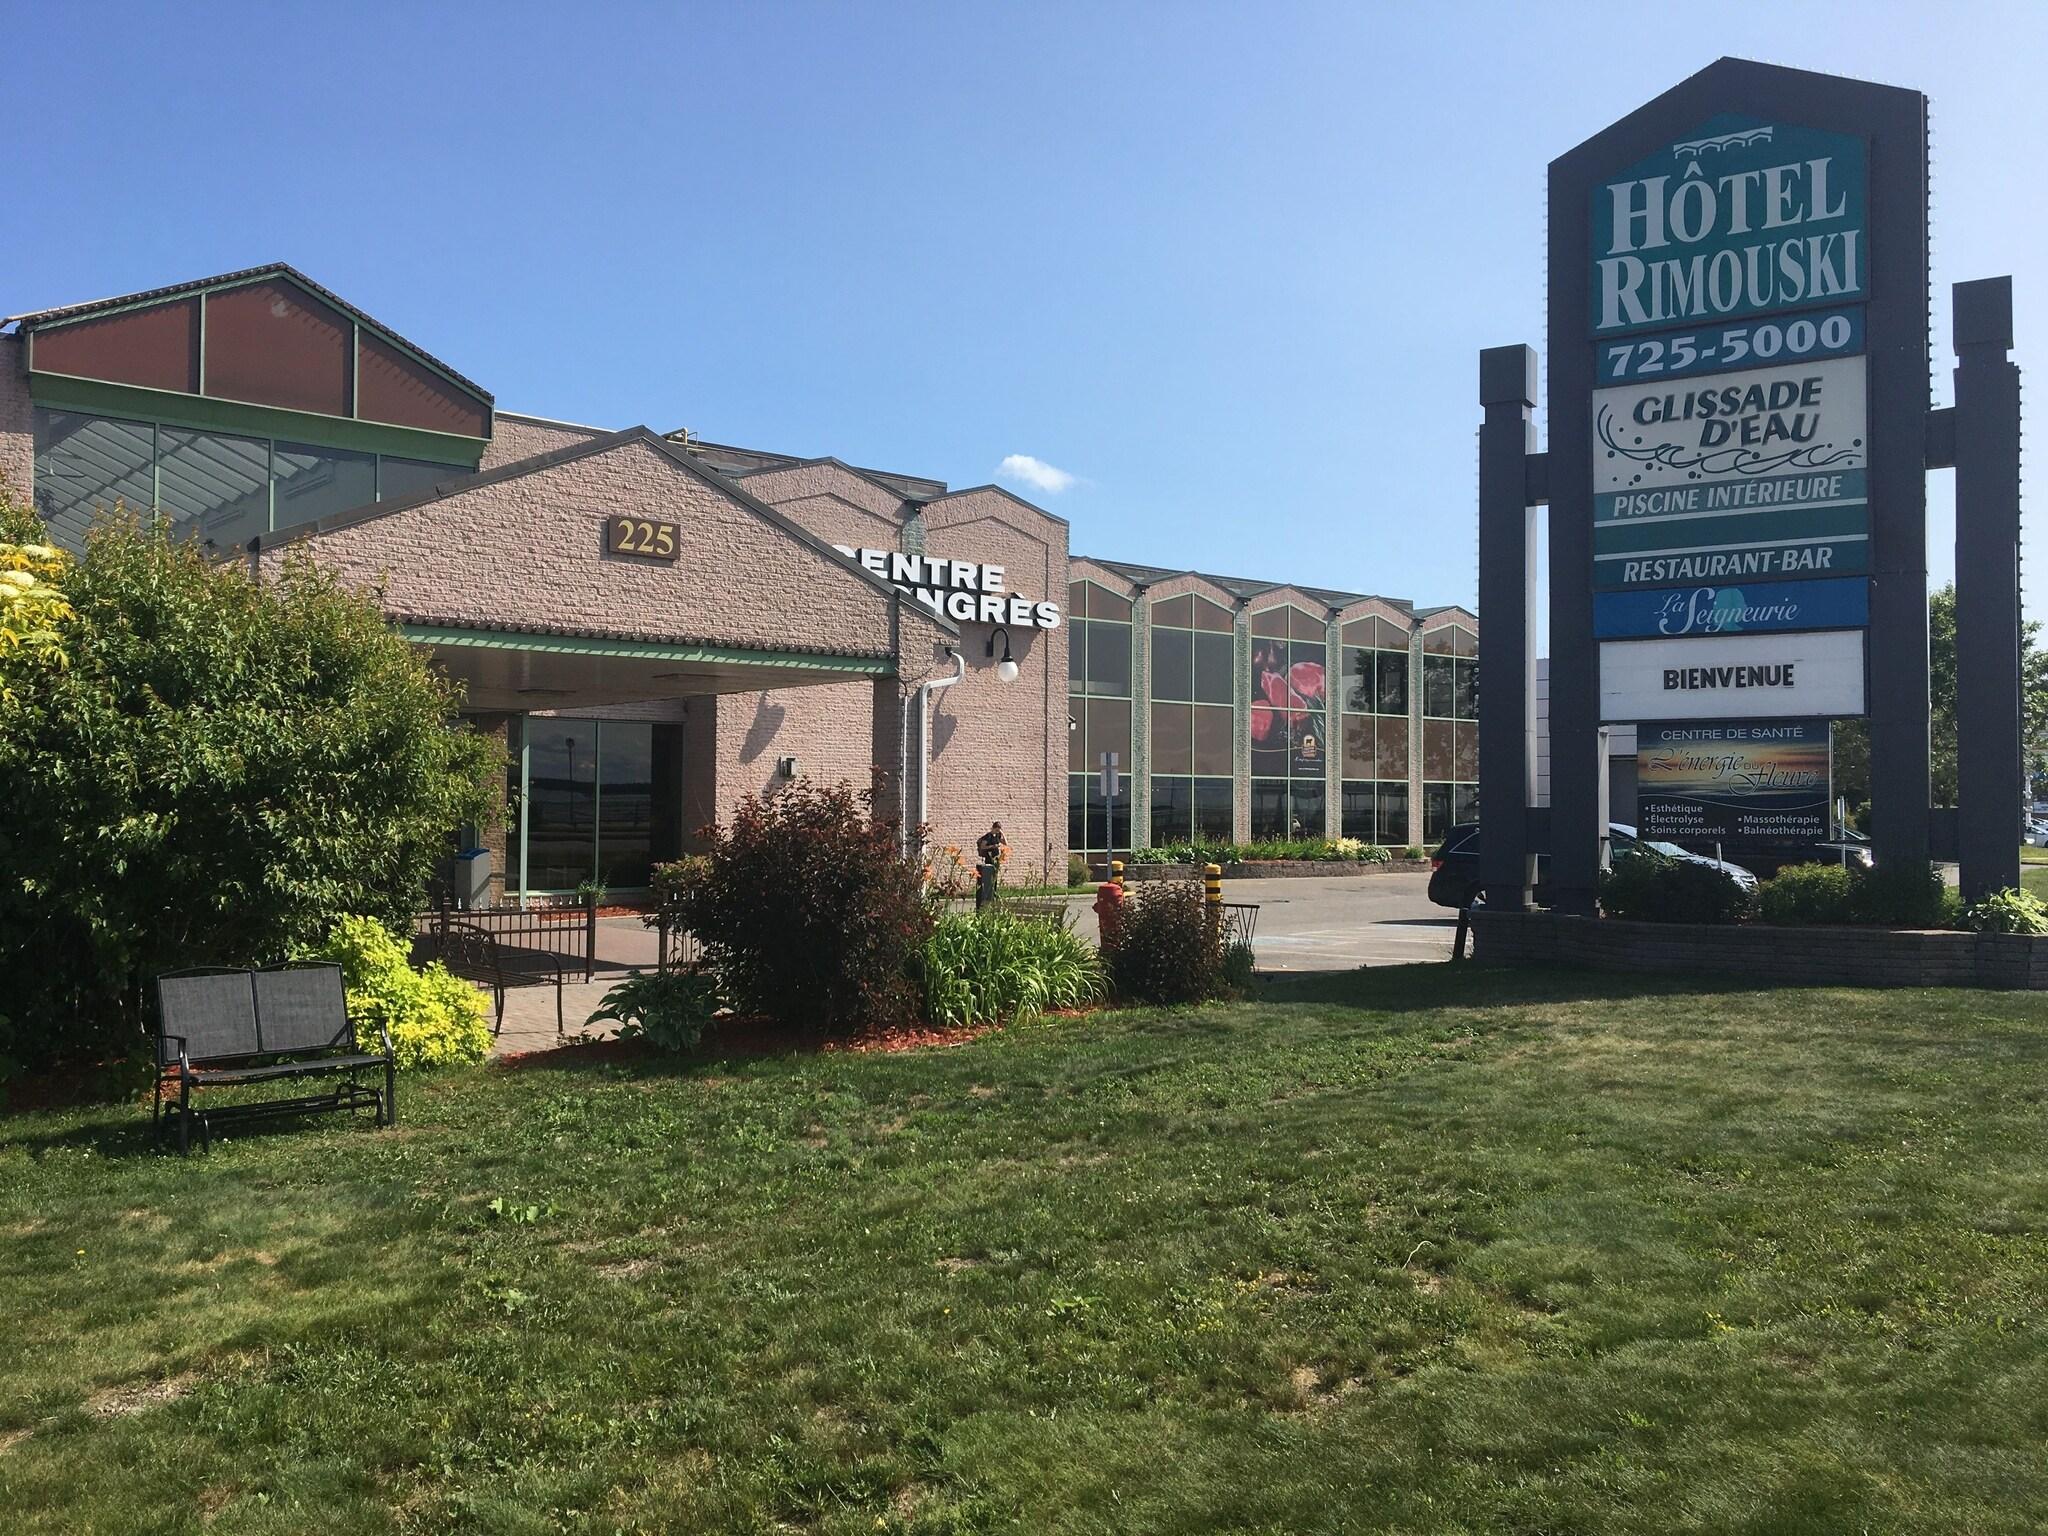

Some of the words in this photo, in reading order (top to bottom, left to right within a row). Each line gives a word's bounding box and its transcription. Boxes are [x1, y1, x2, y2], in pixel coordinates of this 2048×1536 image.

[1606, 156, 1847, 255] HÔTEL
[1595, 229, 1861, 330] RIMOUSKI
[1607, 315, 1851, 377] 725-5000
[1632, 376, 1823, 426] GLISSADE
[1699, 412, 1820, 448] D'EAU
[1613, 488, 1699, 517] PISCINE
[1706, 475, 1842, 508] INTÉRIEURE
[617, 519, 674, 555] 225
[1623, 547, 1833, 583] RESTAURANT-BAR
[893, 584, 1061, 629] NGRÈS
[1654, 592, 1684, 617] La
[1658, 587, 1800, 635] Seigneurie
[1663, 664, 1795, 690] BIENVENUE
[1661, 729, 1722, 741] CENTRE
[1726, 728, 1748, 739] DE
[1751, 725, 1804, 739] SANTÉ
[1650, 747, 1744, 780] L'énergie
[1650, 803, 1703, 814] Esthétique
[1650, 813, 1704, 825] Électrolyse
[1743, 815, 1820, 826] Massothérapie
[1650, 825, 1677, 834] Soins
[1679, 826, 1726, 836] corporels
[1743, 826, 1824, 837] Balnéothérapie
